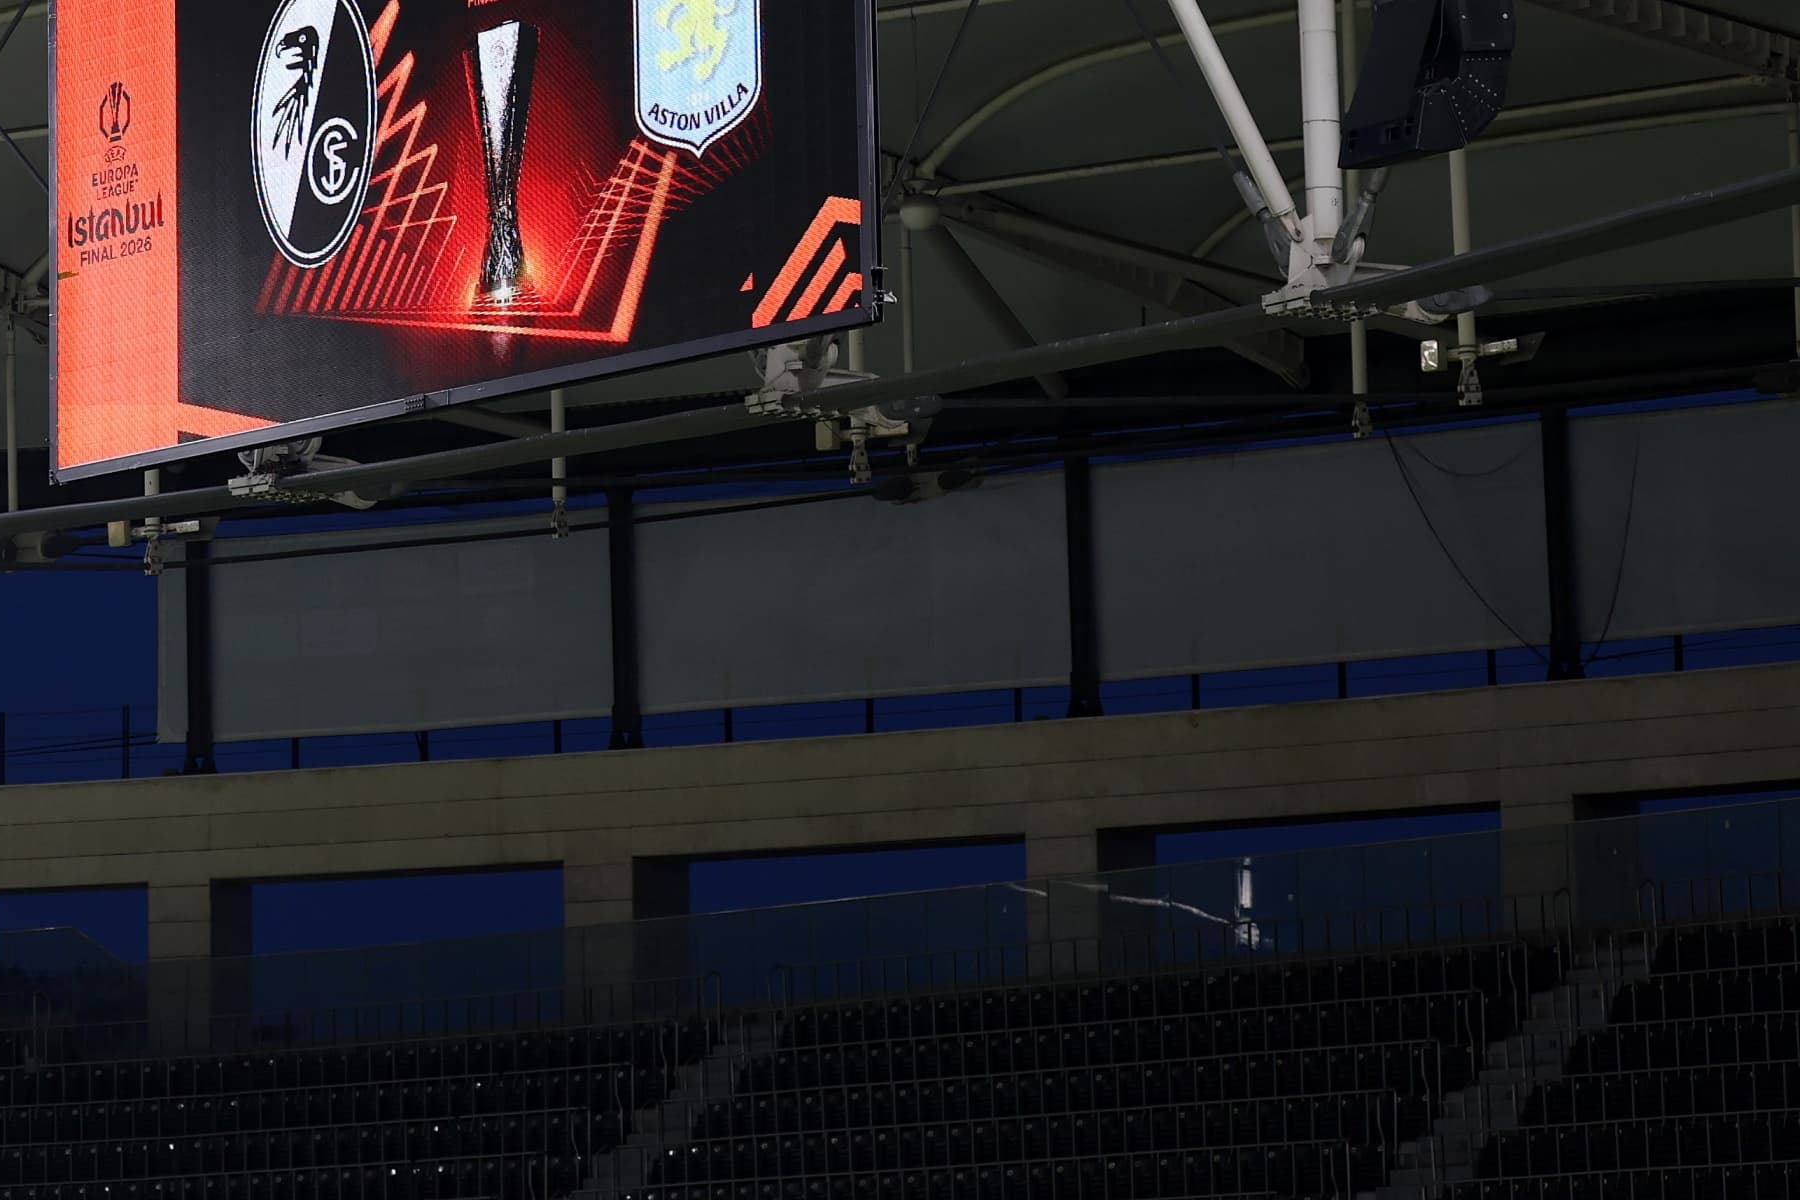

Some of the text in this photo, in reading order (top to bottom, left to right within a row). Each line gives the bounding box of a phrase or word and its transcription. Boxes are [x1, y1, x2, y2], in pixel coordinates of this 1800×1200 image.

[648, 103, 700, 131] ASTON
[704, 82, 749, 125] VILLA
[92, 163, 138, 187] EUROPA
[97, 180, 135, 201] LEAGUE
[80, 235, 152, 267] FINAL 2026
